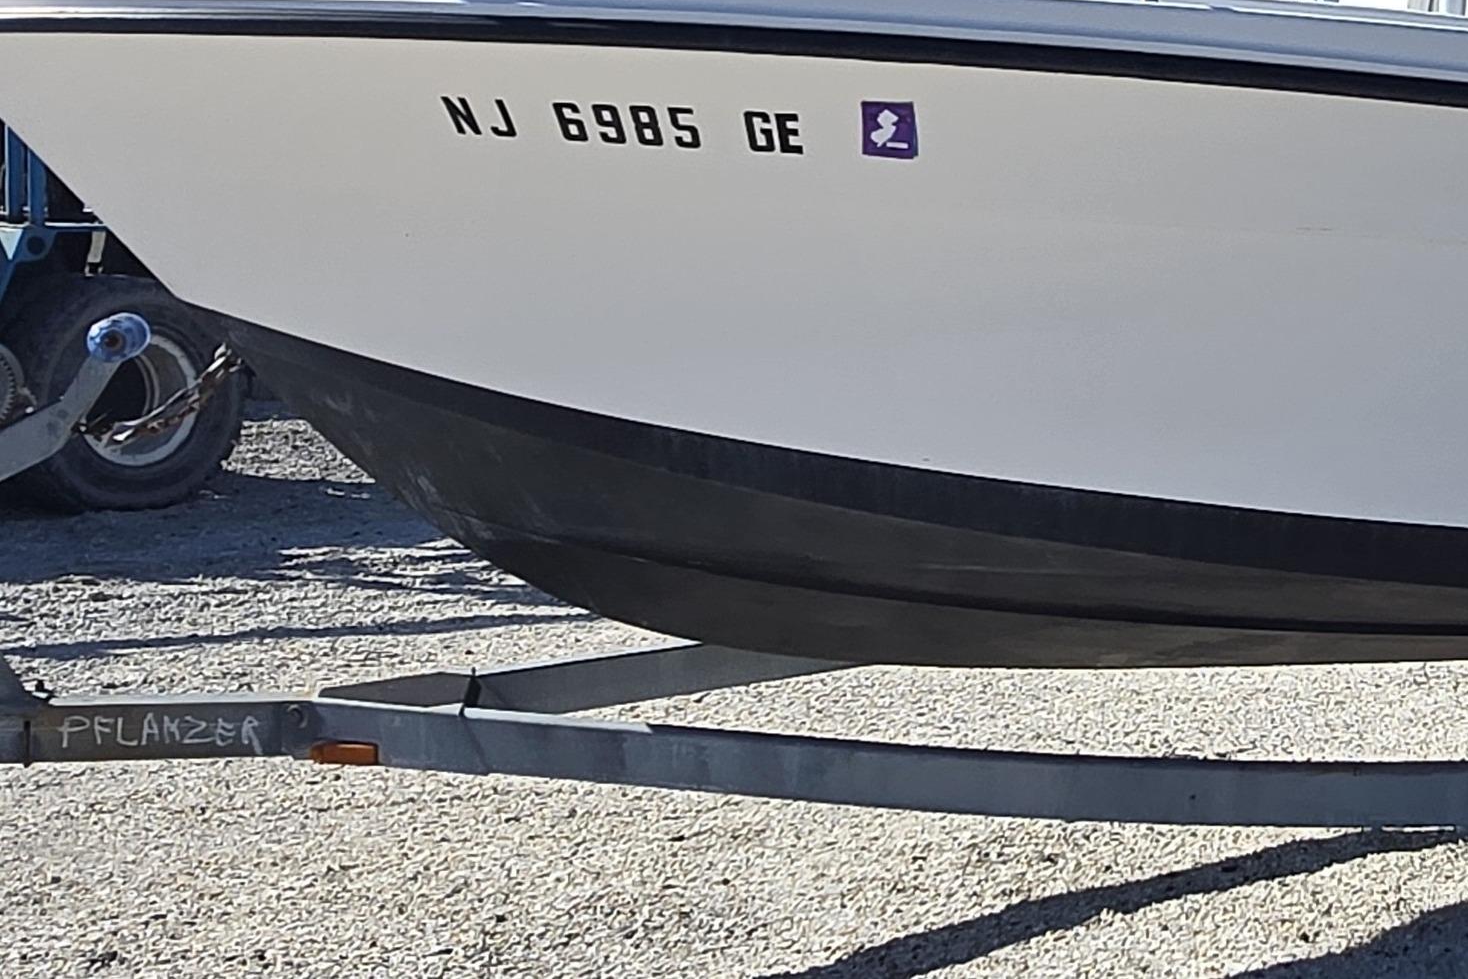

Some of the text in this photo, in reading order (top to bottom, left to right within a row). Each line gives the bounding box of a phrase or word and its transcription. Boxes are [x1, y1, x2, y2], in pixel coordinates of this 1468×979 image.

[440, 96, 804, 155] NJ 6985 GE
